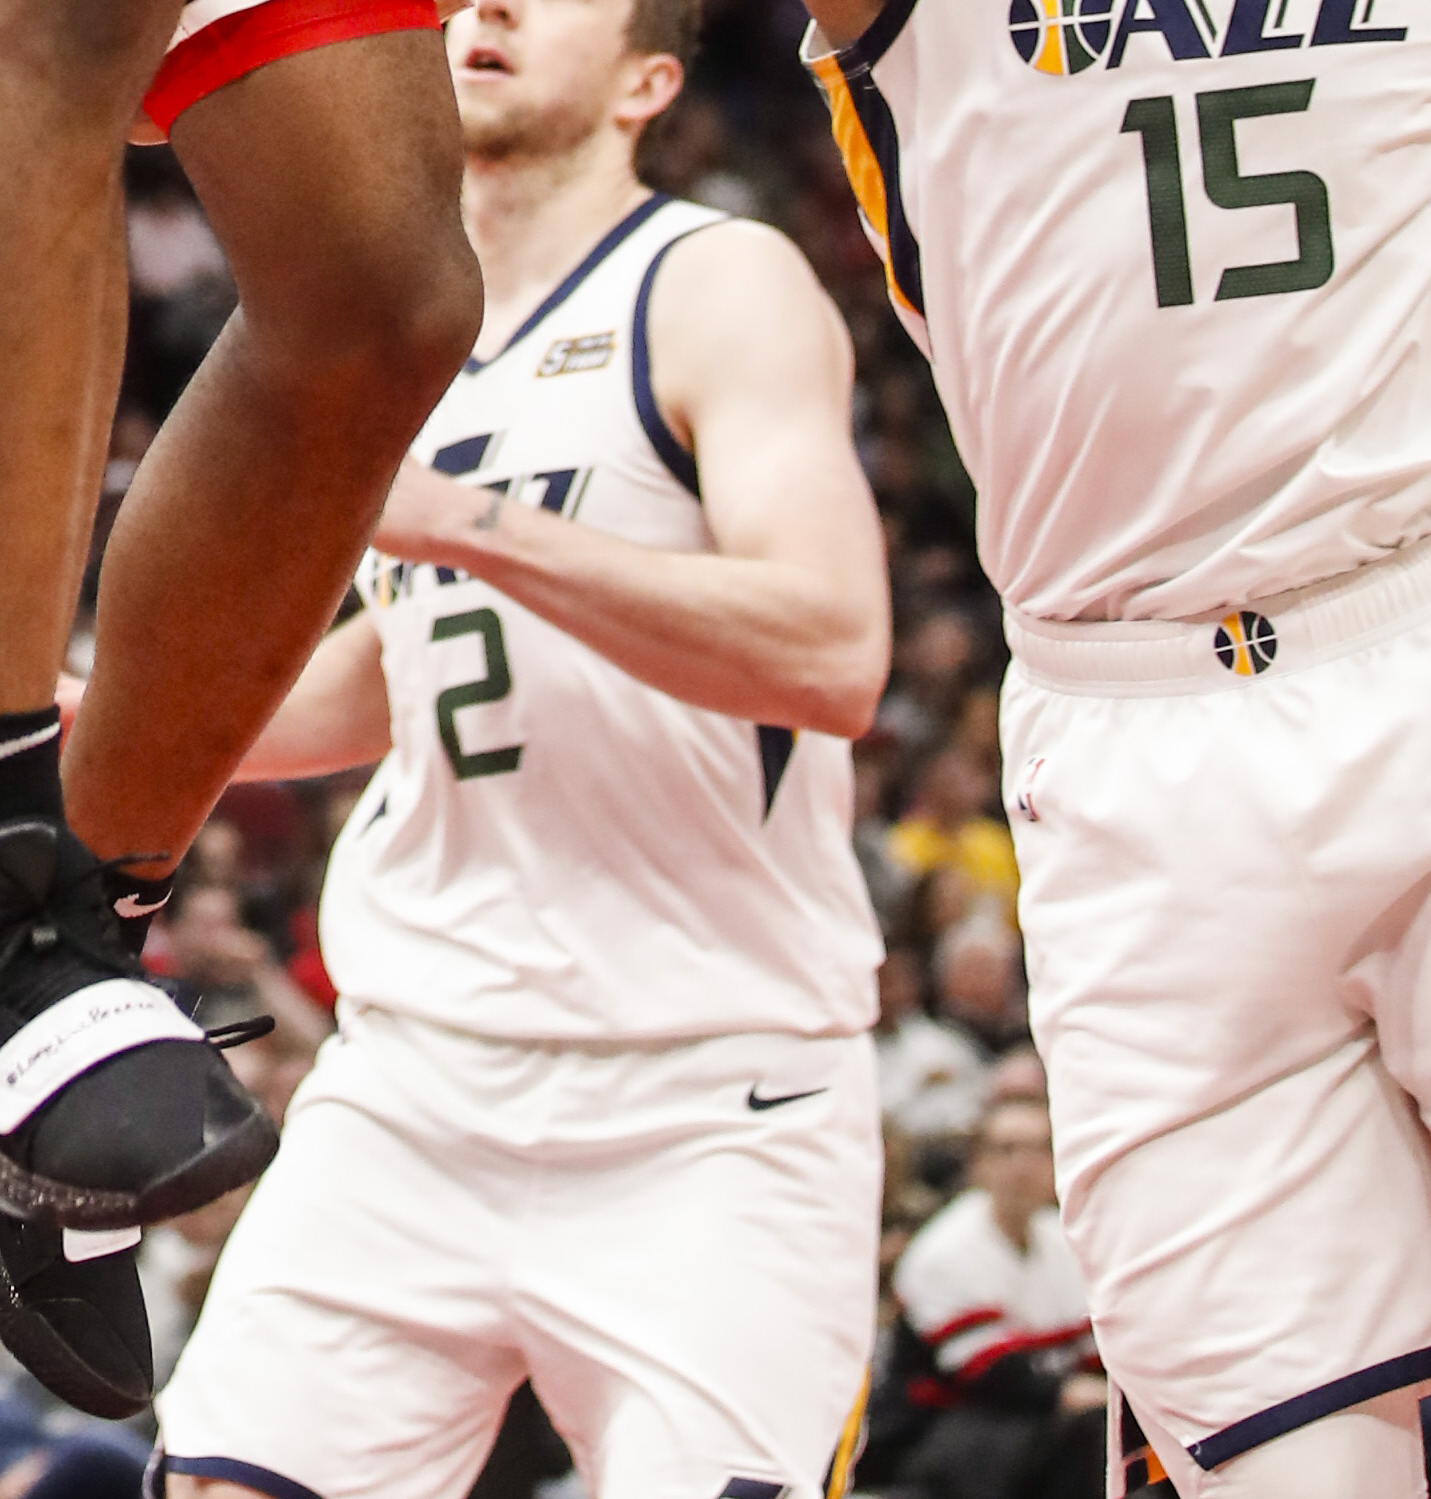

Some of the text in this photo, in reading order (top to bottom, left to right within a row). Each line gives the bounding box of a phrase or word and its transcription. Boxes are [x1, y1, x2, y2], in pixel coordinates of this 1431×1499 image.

[1119, 77, 1335, 309] 15
[541, 341, 572, 377] 5
[430, 607, 525, 782] 2
